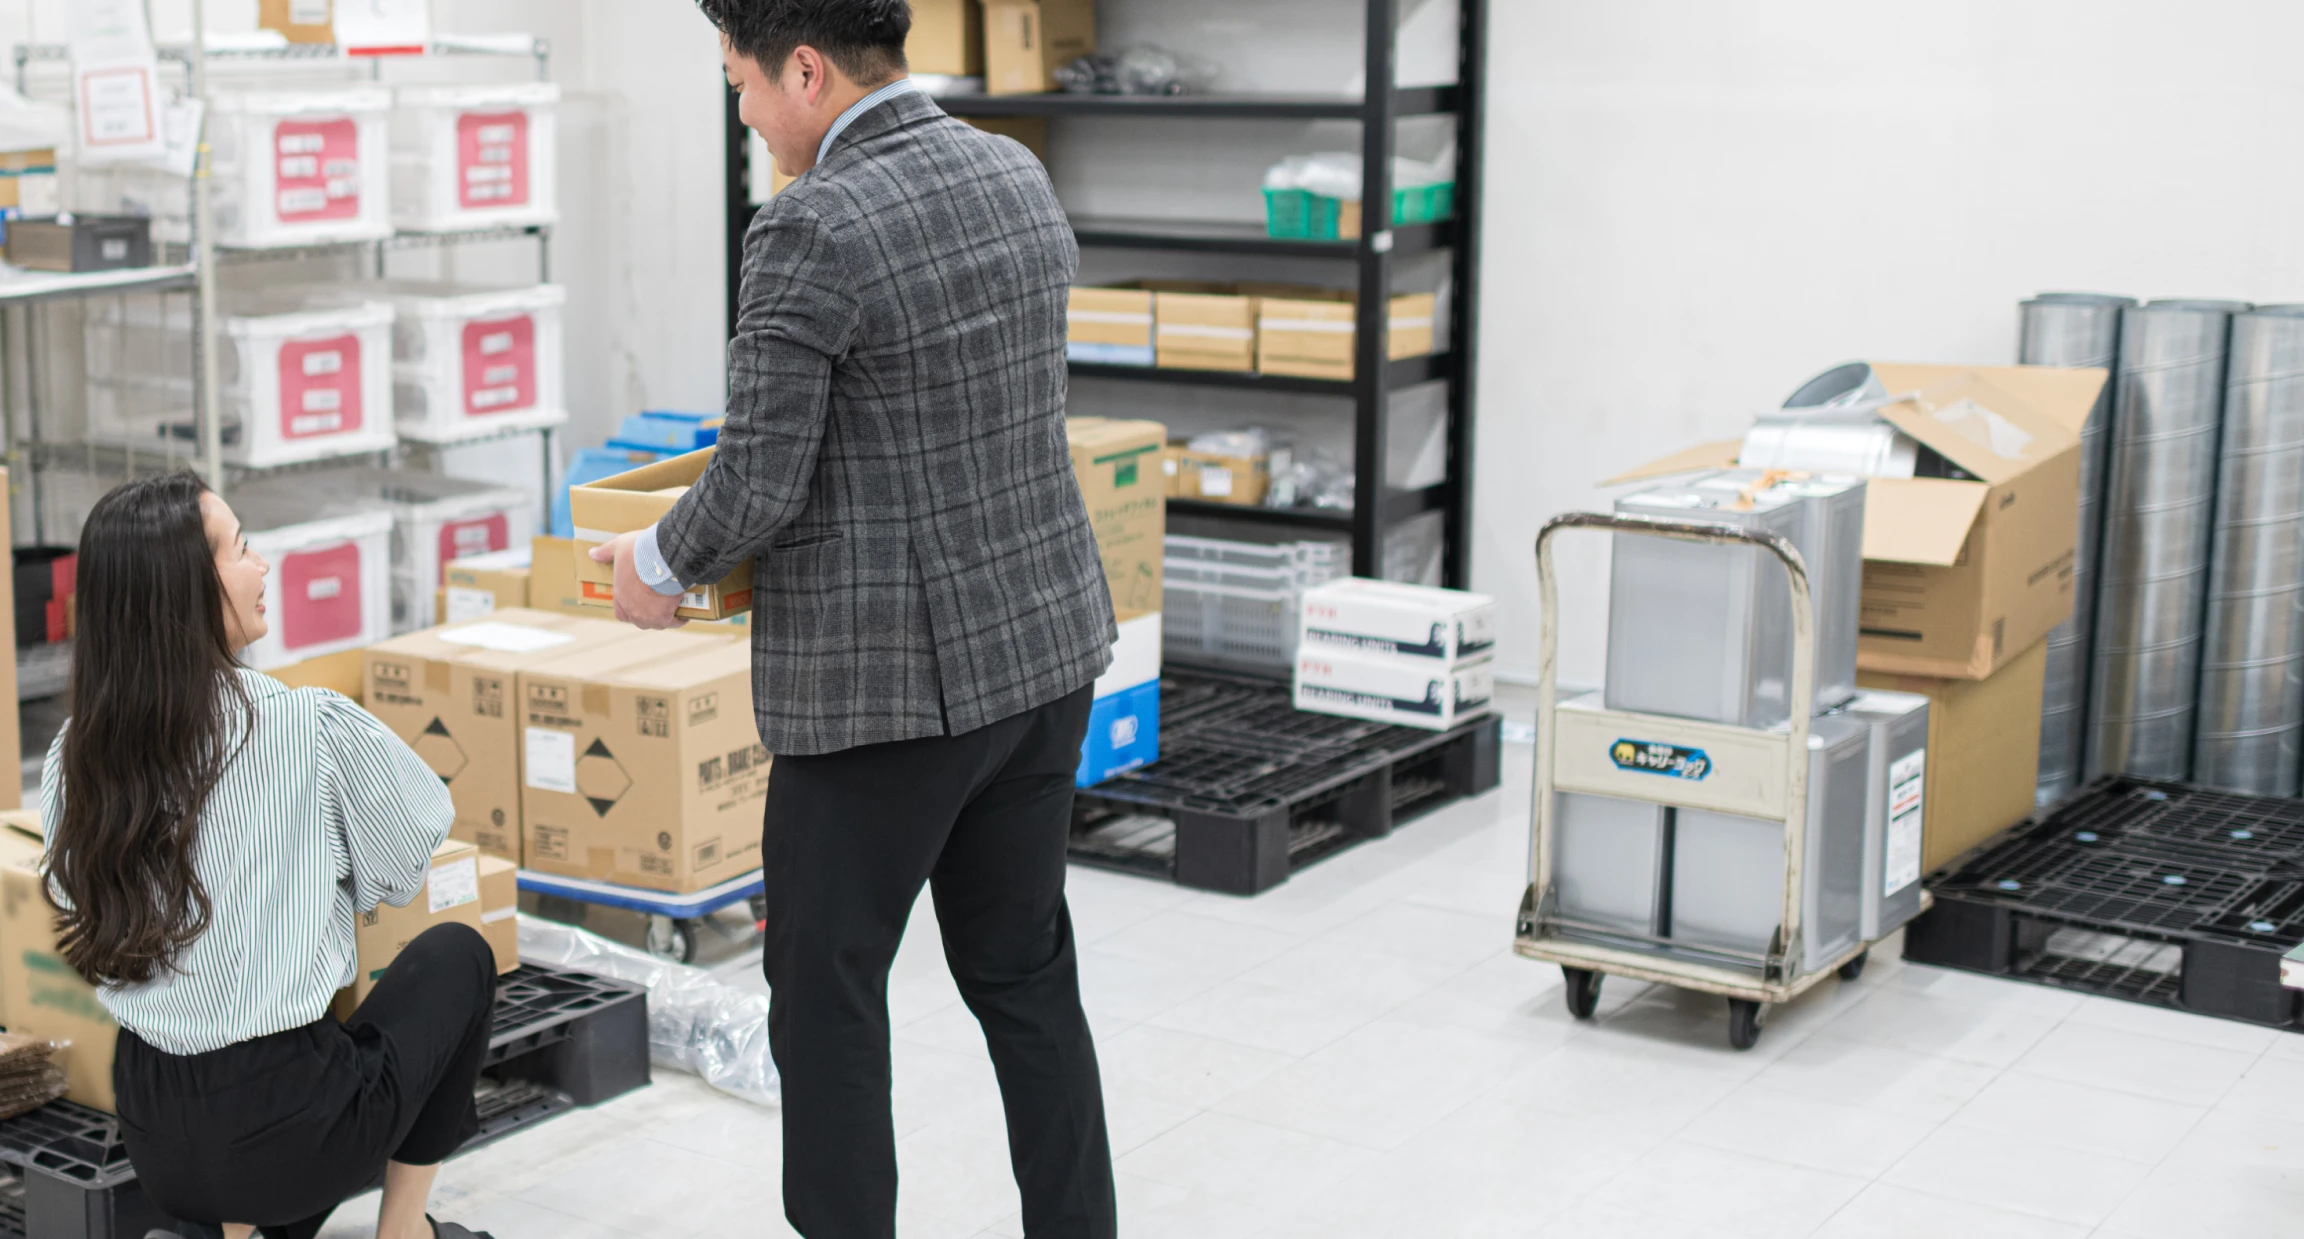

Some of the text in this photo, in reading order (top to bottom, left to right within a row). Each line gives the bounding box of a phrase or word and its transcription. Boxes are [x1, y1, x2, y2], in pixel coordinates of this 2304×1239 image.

[1307, 629, 1397, 652] BEARING UNITS
[1302, 685, 1392, 708] BEARING UNITS
